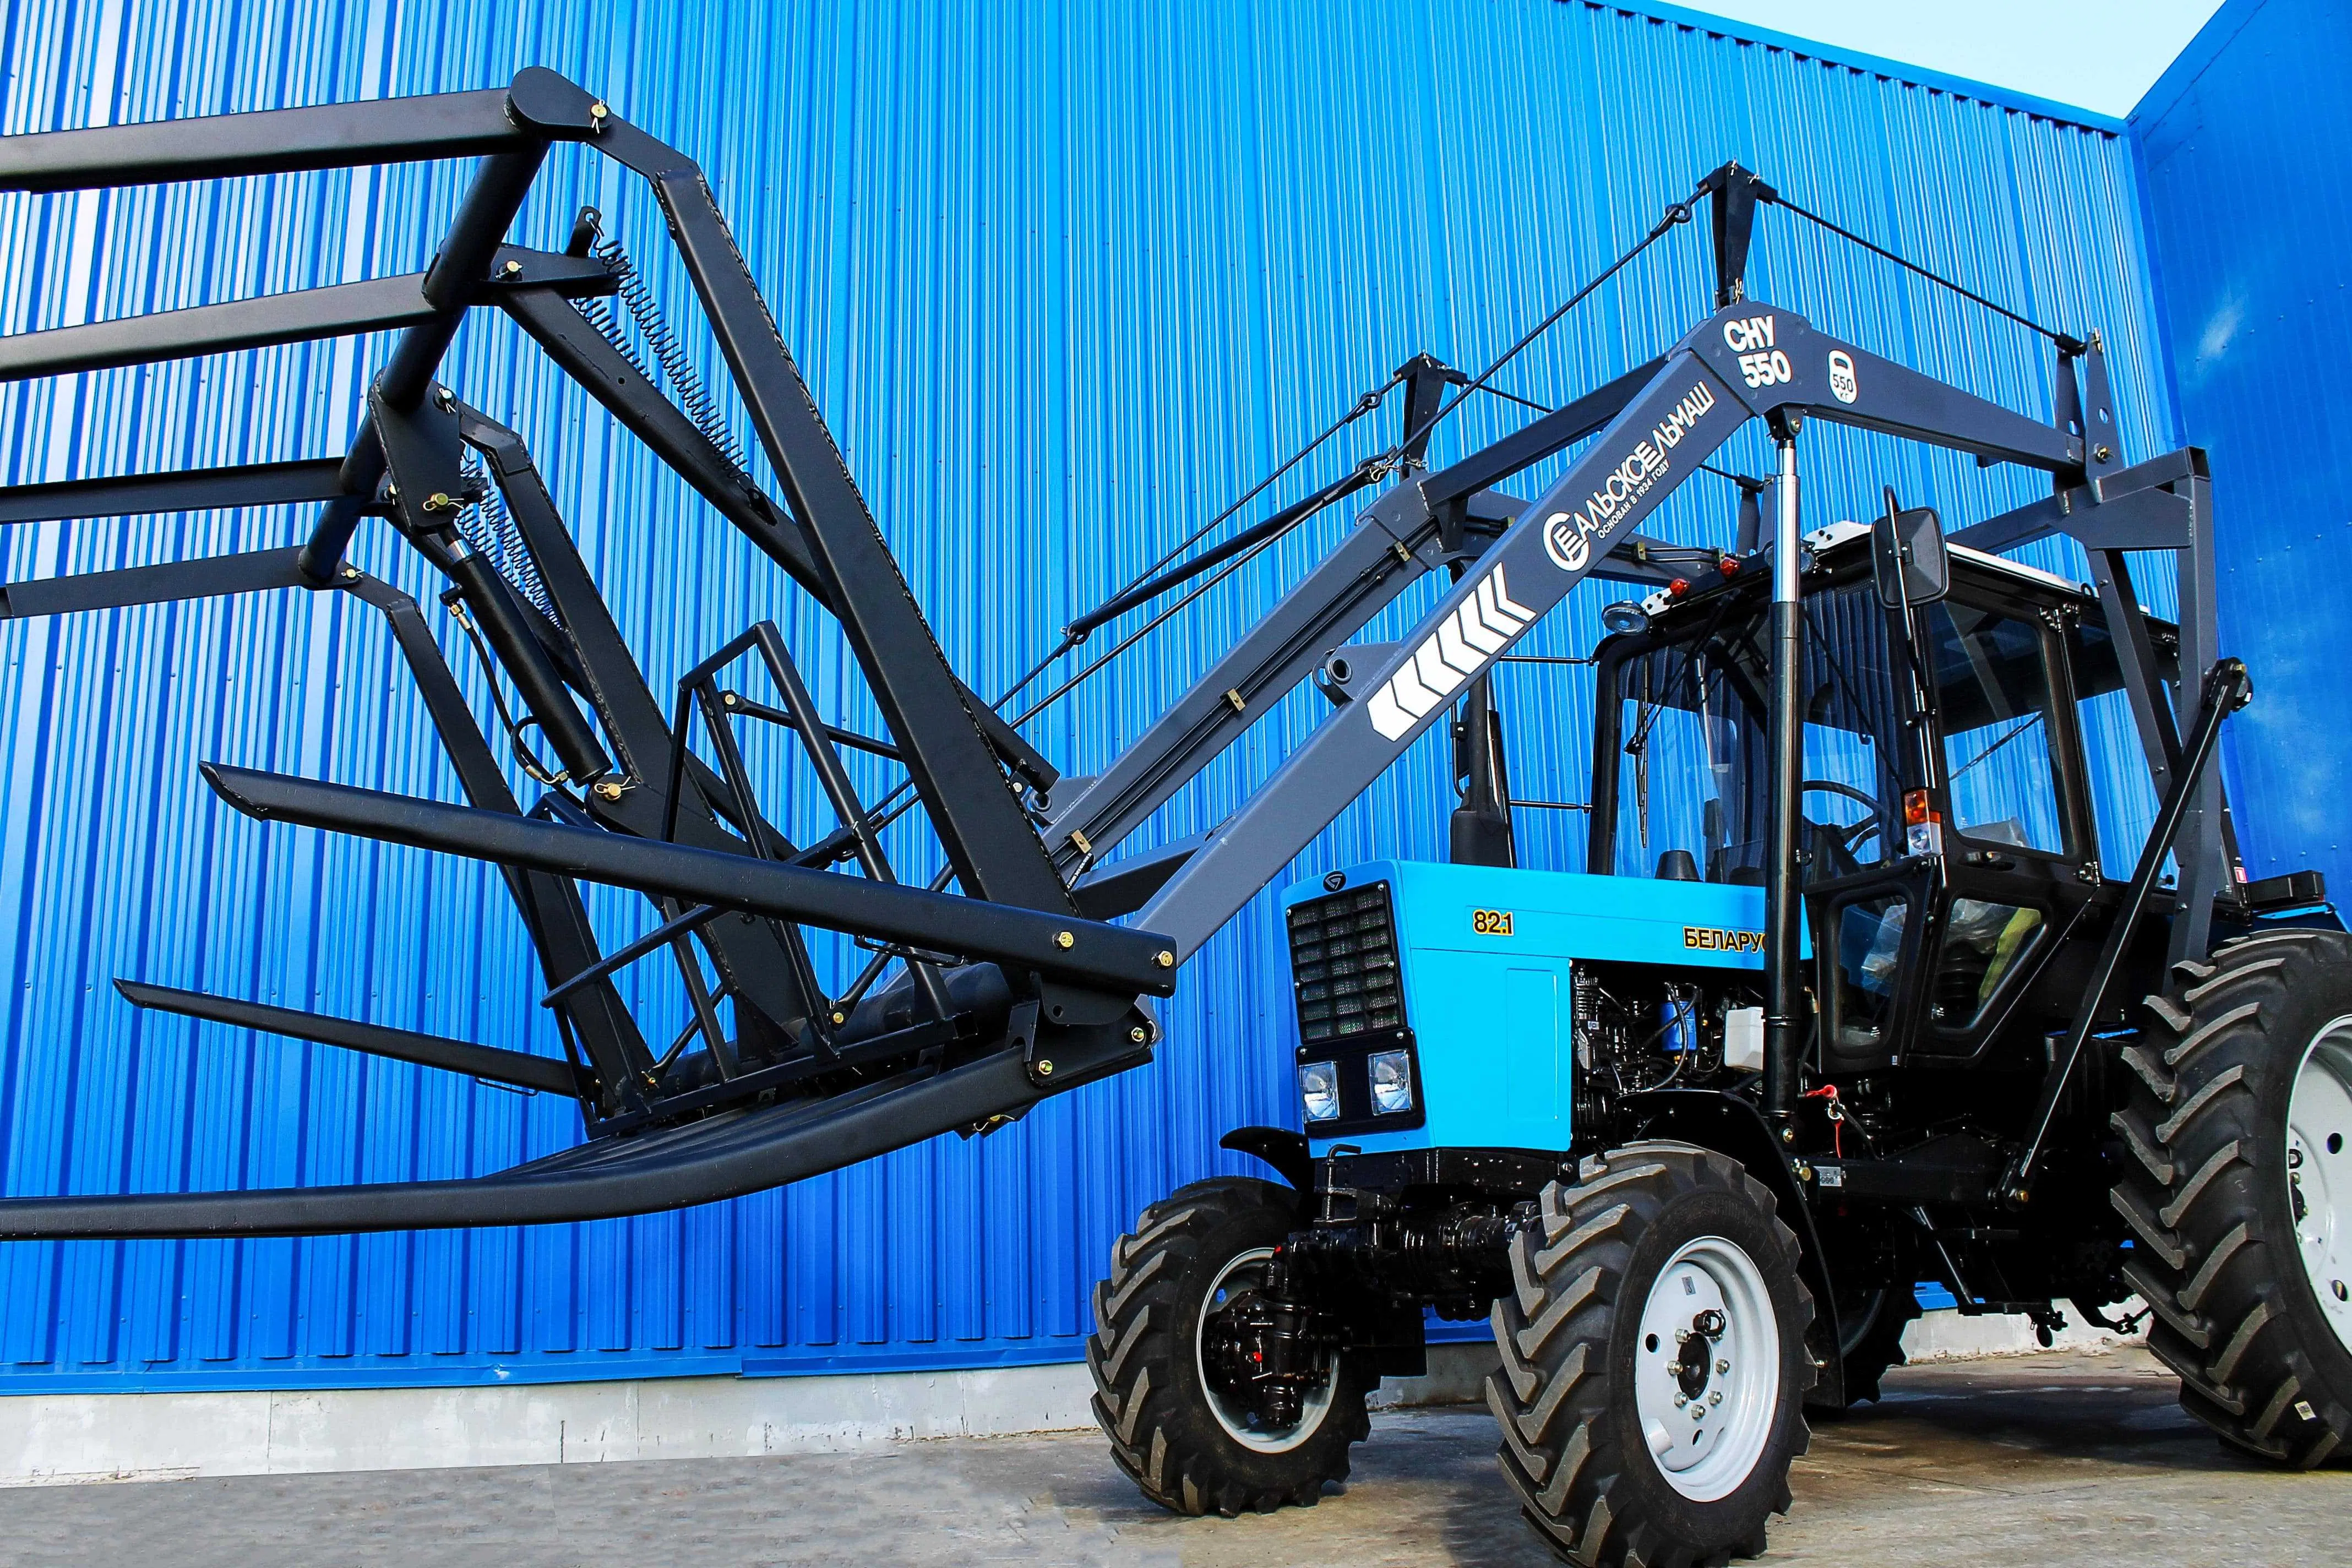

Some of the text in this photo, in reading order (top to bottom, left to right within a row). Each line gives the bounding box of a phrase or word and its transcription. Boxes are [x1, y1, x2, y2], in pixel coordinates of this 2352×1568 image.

[1723, 315, 1775, 353] СНУ
[1738, 349, 1793, 389] 550
[1833, 373, 1853, 393] 550
[1597, 459, 1670, 538] ОСНОВАН В 1934 ГОДУ
[1473, 910, 1513, 935] 82.1
